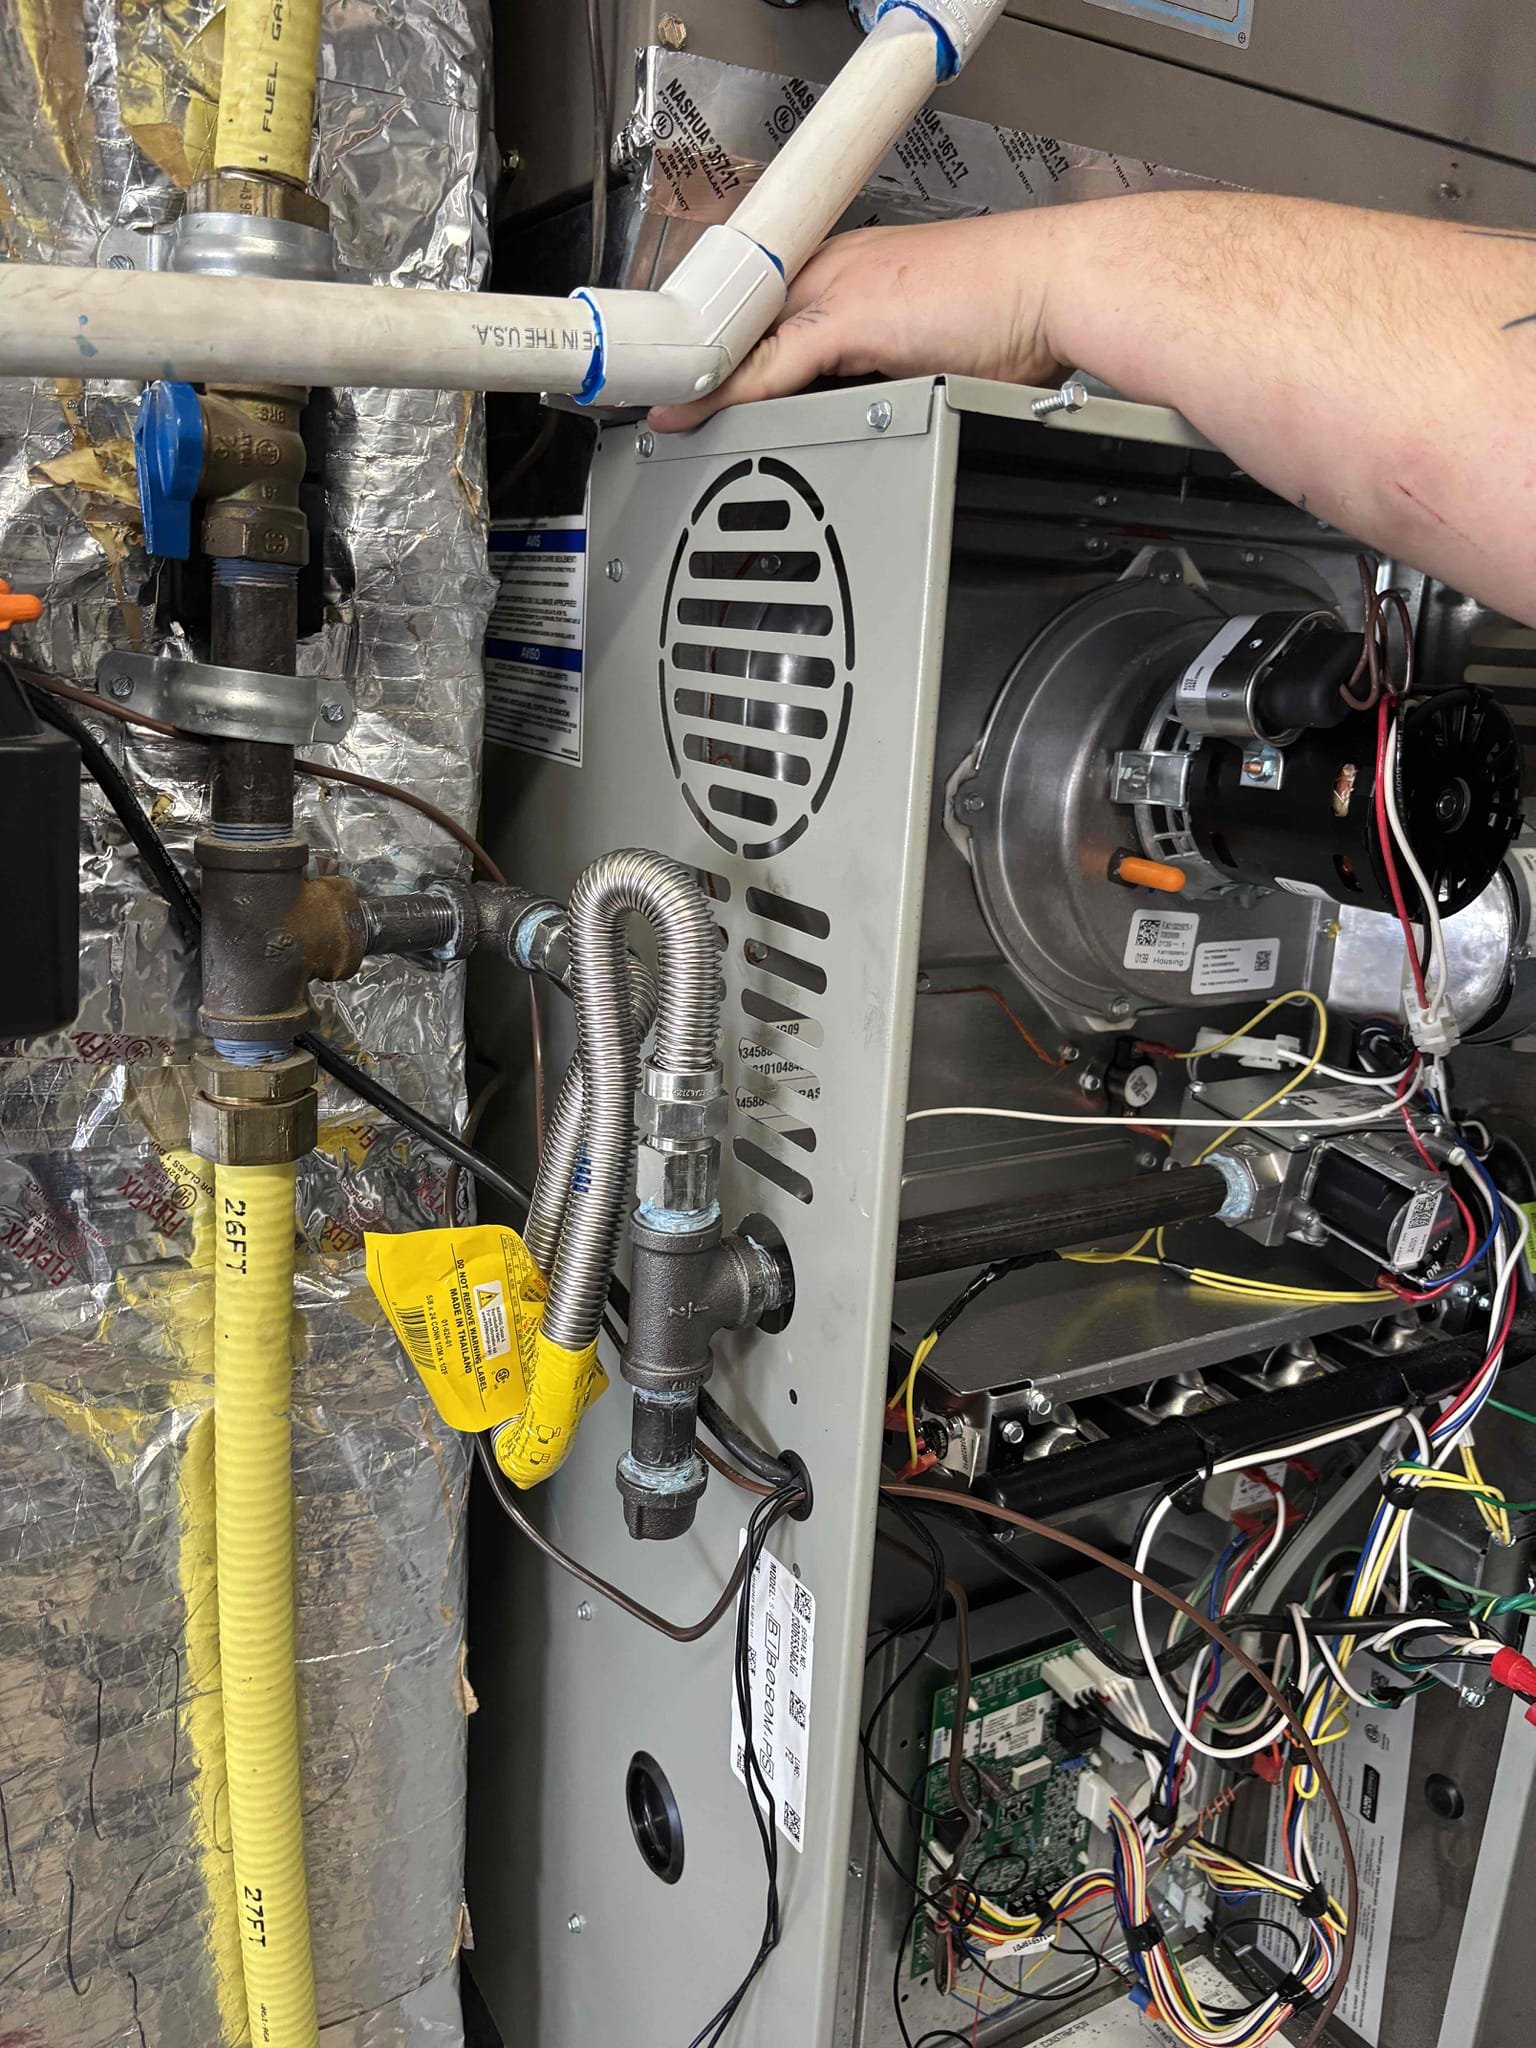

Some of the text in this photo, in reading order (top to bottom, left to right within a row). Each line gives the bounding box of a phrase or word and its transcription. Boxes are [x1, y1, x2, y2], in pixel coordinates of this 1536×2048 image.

[262, 62, 279, 133] FUEL
[271, 0, 284, 41] GA
[677, 137, 698, 170] LISTED
[911, 128, 932, 160] LISTED
[655, 149, 673, 180] CLASS
[699, 157, 725, 200] SEALANT
[525, 327, 559, 349] THE
[562, 329, 579, 349] IN
[1153, 957, 1184, 966] Housing
[172, 1160, 201, 1183] CLASS
[117, 1175, 186, 1237] FLEXFIX
[224, 1198, 247, 1274] 26FT
[2, 1223, 75, 1286] FLEXFIX
[1425, 1261, 1442, 1280] ON
[431, 1323, 440, 1342] CONN
[441, 1319, 453, 1347] 01-624-01
[450, 1288, 473, 1374] MADE IN THAILAND
[456, 1259, 489, 1392] DO NOT REMOVE WARNING LABEL
[435, 1343, 445, 1357] 1/2M
[768, 1561, 778, 1599] MODEL:
[799, 1624, 808, 1653] SERIAL
[785, 1746, 794, 1765] F2
[244, 1885, 266, 1948] 27FT
